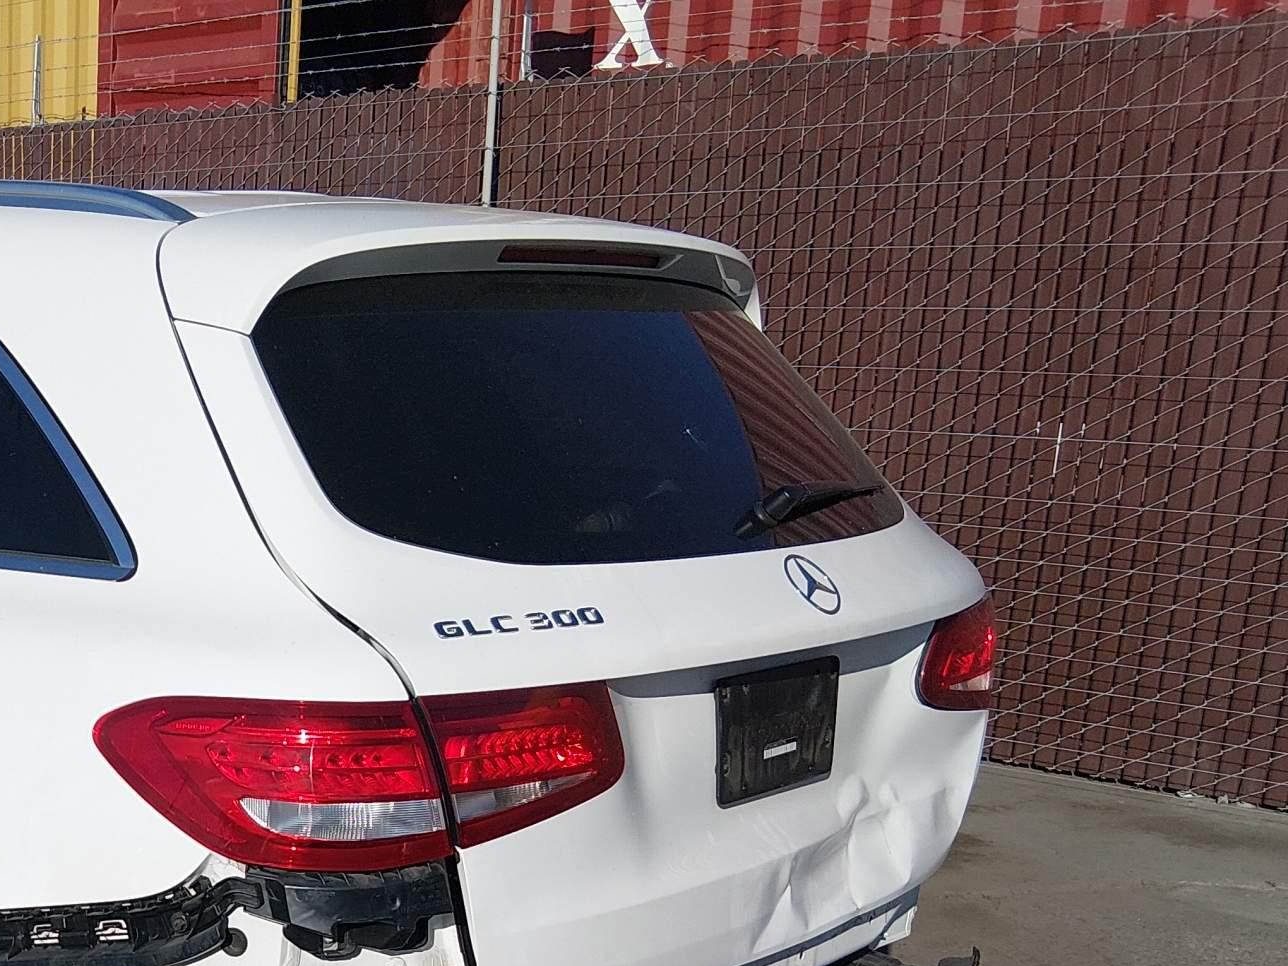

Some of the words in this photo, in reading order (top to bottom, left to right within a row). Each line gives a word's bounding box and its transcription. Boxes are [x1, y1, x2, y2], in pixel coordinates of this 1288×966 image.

[595, 0, 663, 68] X
[433, 616, 520, 639] GLC
[525, 607, 604, 631] 300
